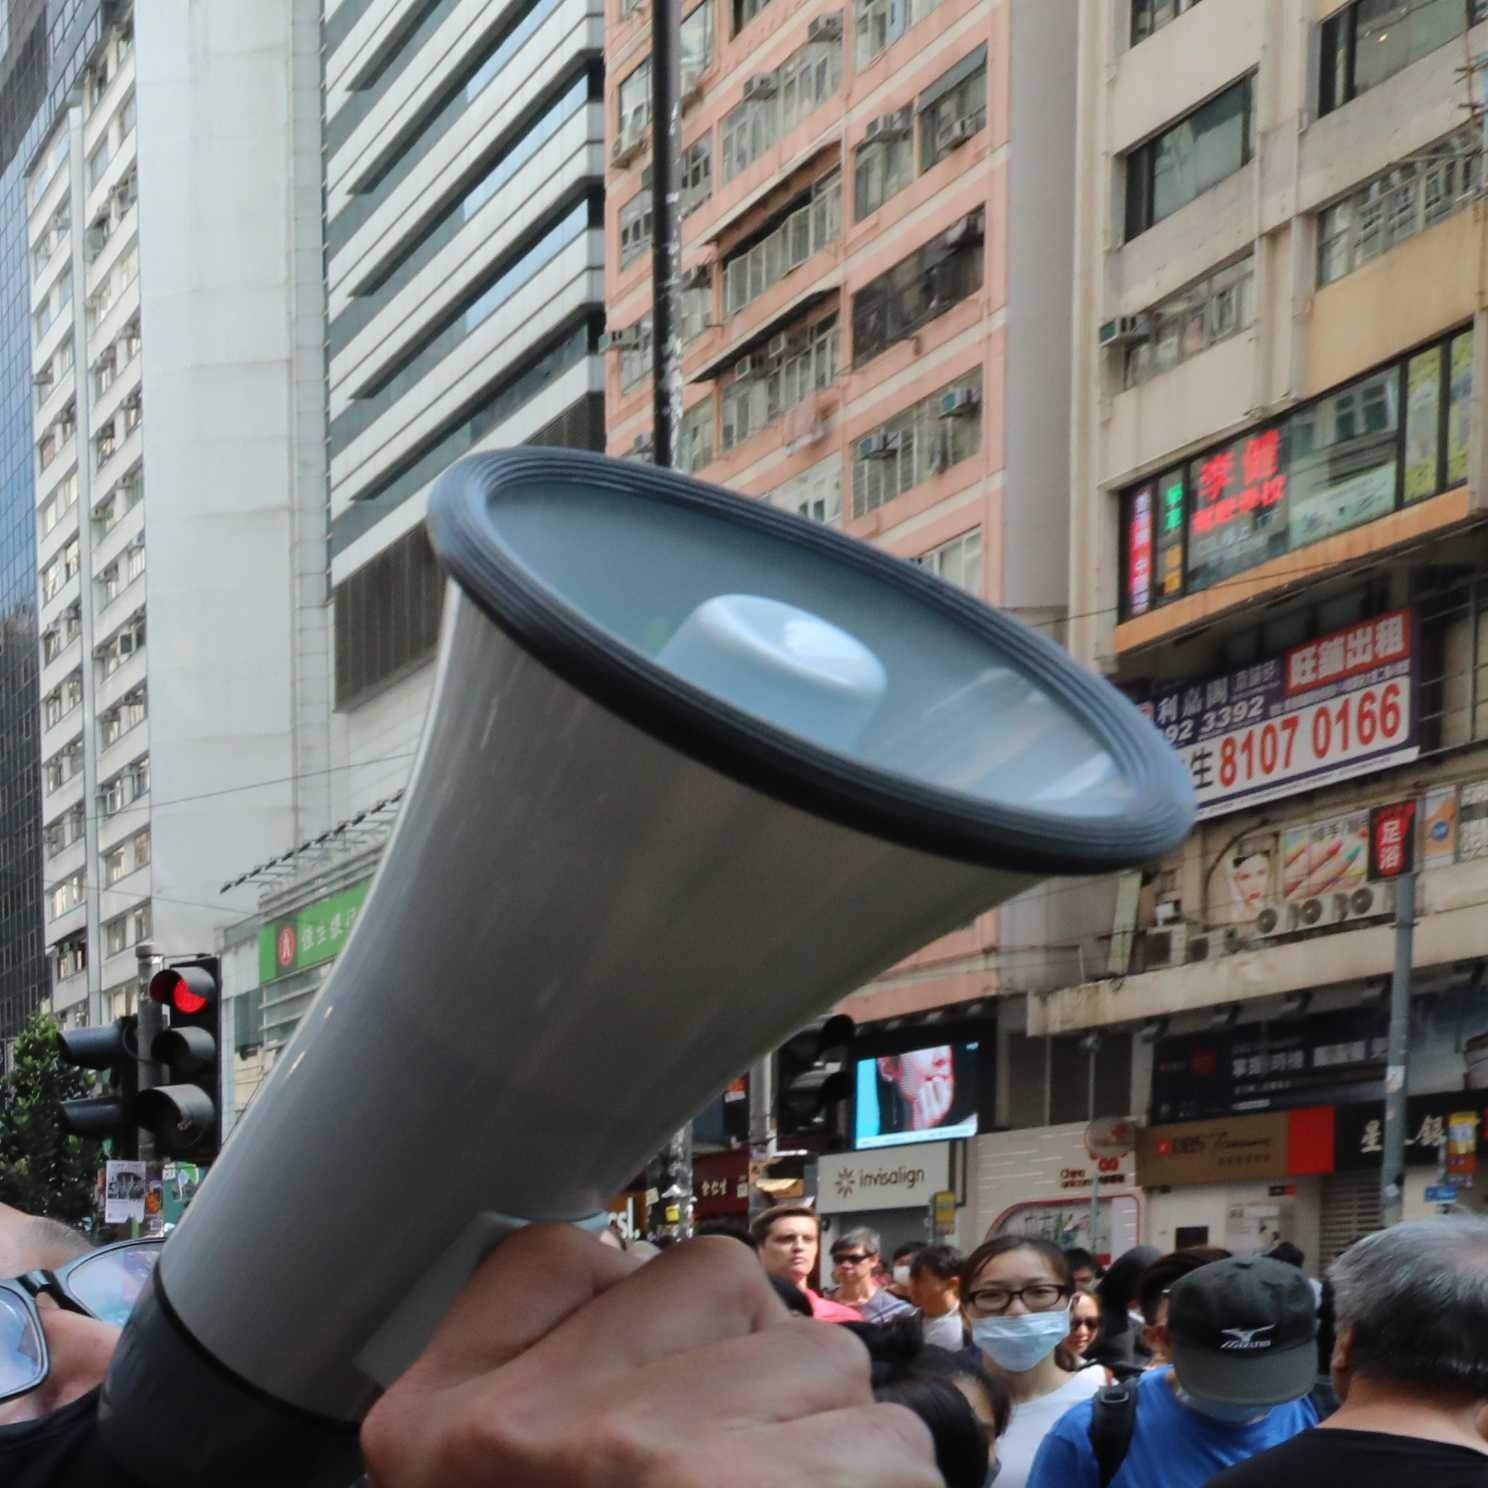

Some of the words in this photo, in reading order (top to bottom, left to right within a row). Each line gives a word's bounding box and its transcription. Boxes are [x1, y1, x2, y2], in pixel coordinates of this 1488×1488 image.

[1200, 696, 1264, 734] 3392
[1220, 714, 1299, 787] 8107
[1313, 683, 1400, 759] 0166
[859, 1165, 924, 1188] invisalign
